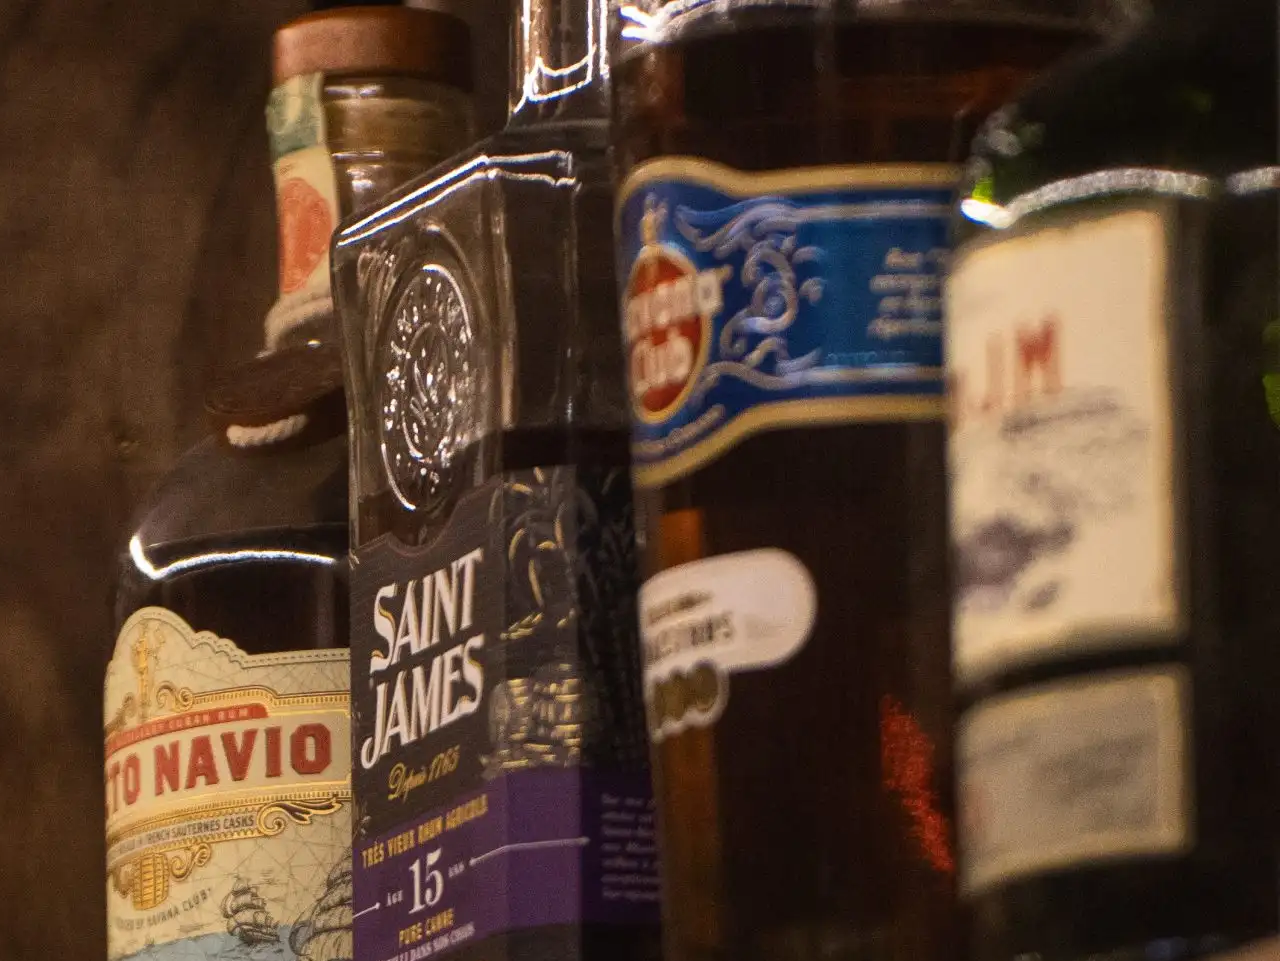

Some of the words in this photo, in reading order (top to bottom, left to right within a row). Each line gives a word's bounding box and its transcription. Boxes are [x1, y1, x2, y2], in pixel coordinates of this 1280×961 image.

[370, 547, 484, 674] SAINT
[360, 632, 485, 770] JAMES
[107, 752, 141, 812] TO
[152, 722, 332, 797] NAVIO
[171, 818, 221, 838] SAUTERNES
[223, 814, 255, 830] CASKS
[182, 888, 208, 911] CLUB
[408, 847, 444, 914] 15
